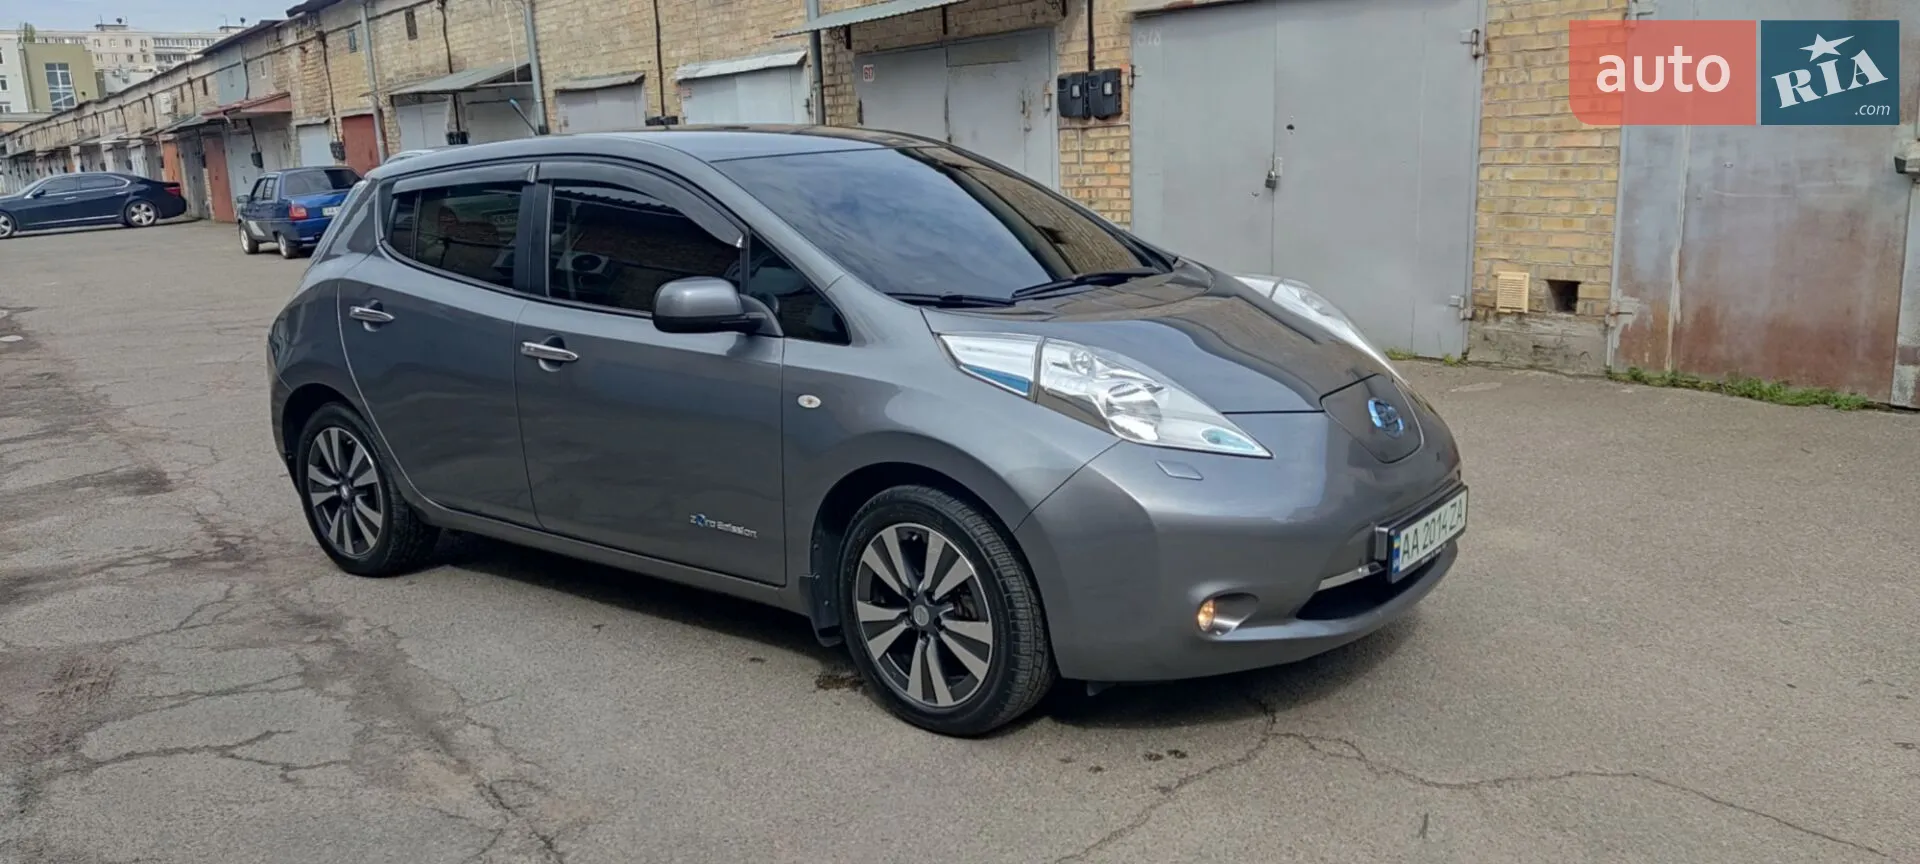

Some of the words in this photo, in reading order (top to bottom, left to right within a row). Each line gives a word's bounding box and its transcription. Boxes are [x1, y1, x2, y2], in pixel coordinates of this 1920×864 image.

[1401, 528, 1420, 565] AA
[1422, 509, 1449, 549] 2014
[1449, 498, 1463, 530] ZA
